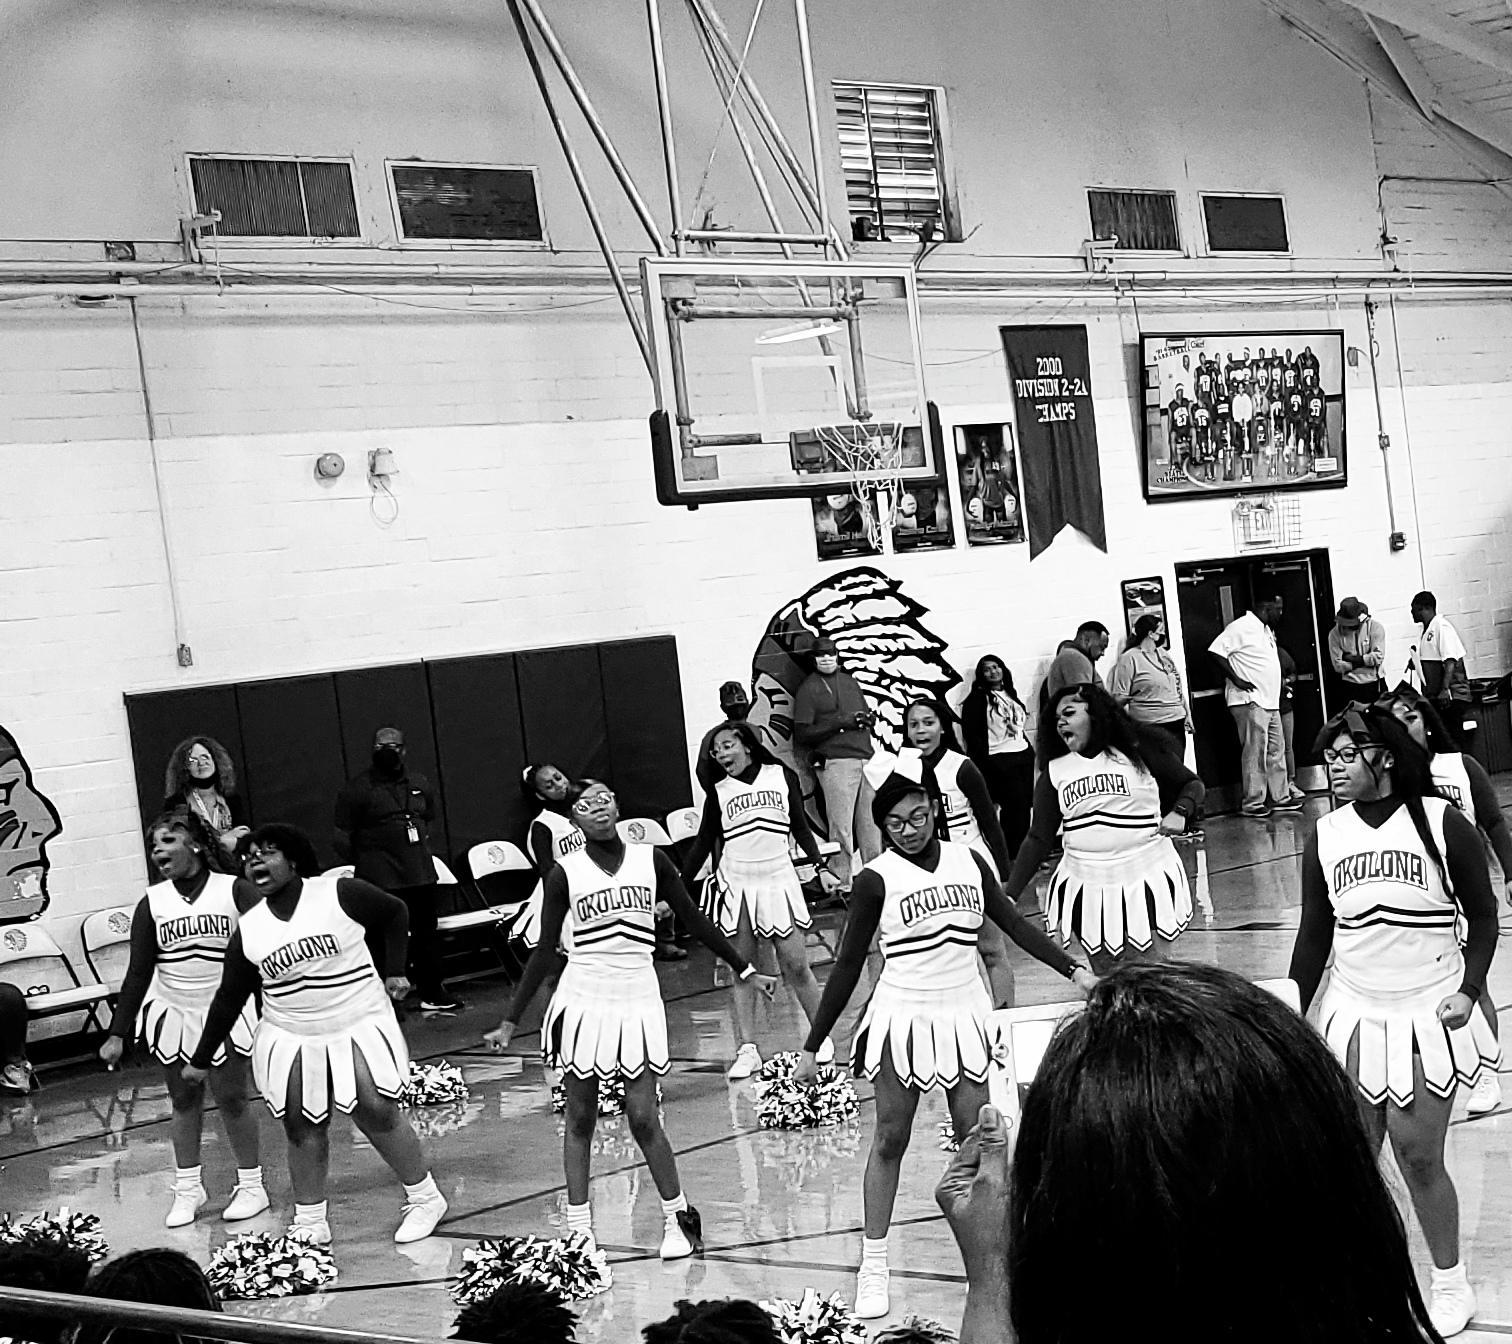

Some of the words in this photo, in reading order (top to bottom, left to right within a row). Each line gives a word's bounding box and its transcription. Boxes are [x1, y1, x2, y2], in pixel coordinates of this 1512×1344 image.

[1036, 357, 1063, 376] 2000
[1015, 378, 1060, 398] DIVISION
[1035, 402, 1076, 423] CHAMPS
[726, 790, 786, 821] OKOLONA
[1062, 773, 1131, 809] OKOLONA
[1333, 850, 1429, 898] OKOLONA
[576, 885, 653, 923] OKOLONA
[899, 883, 984, 927] OKOLONA
[159, 914, 233, 947] OKOLONA
[260, 933, 343, 980] OKOLONA
